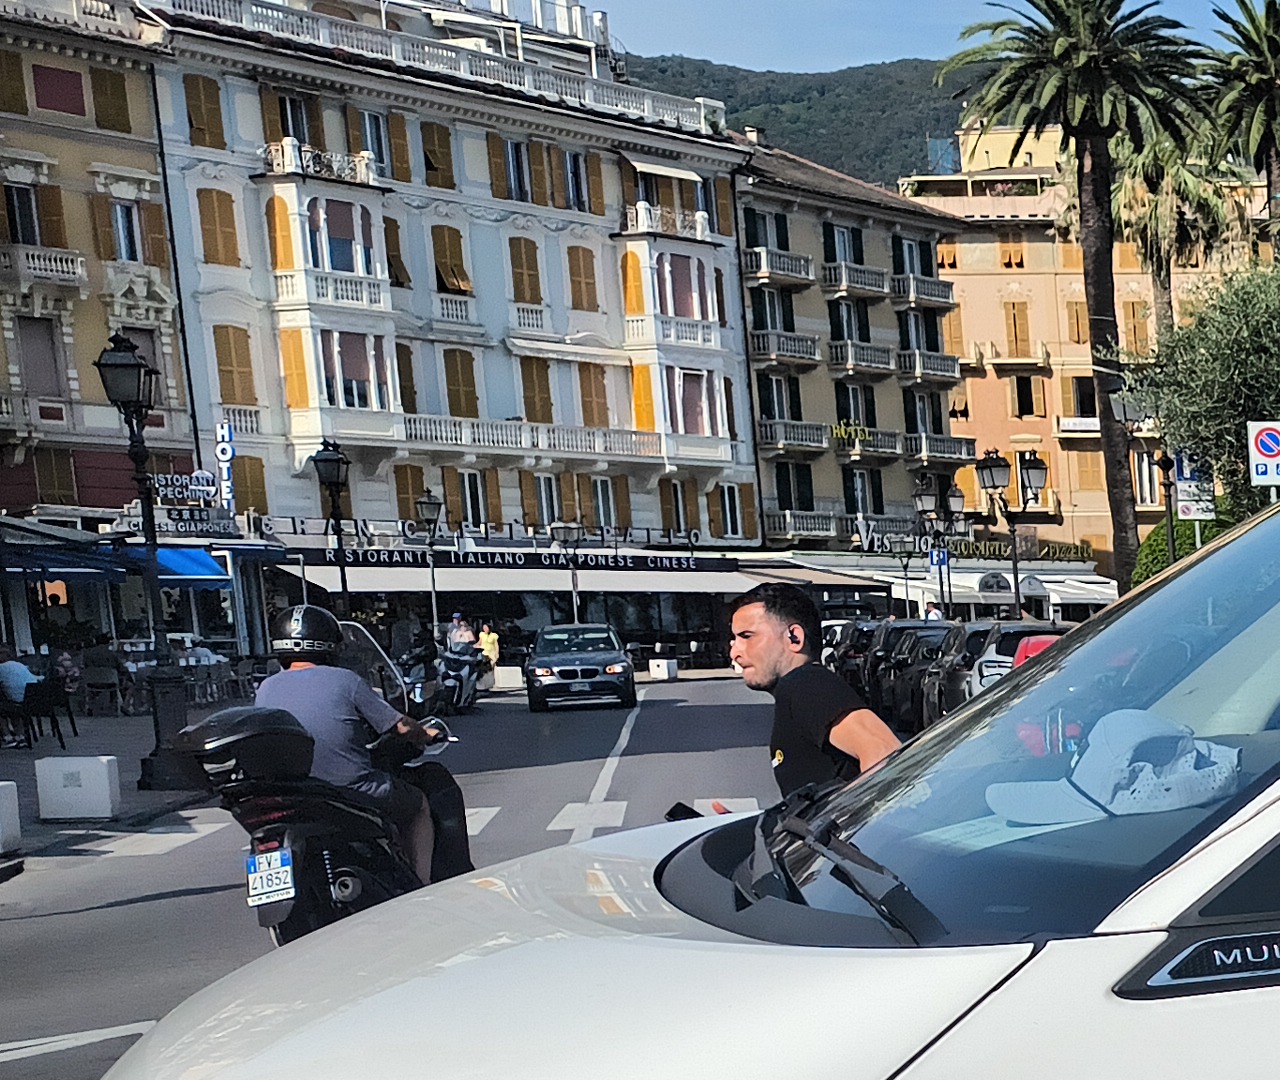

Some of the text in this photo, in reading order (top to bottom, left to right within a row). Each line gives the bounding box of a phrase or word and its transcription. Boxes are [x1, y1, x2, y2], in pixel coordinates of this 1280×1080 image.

[130, 521, 176, 532] CIESE
[326, 551, 697, 569] RSTORANTE ITALIANO GIAPONESE CINESE
